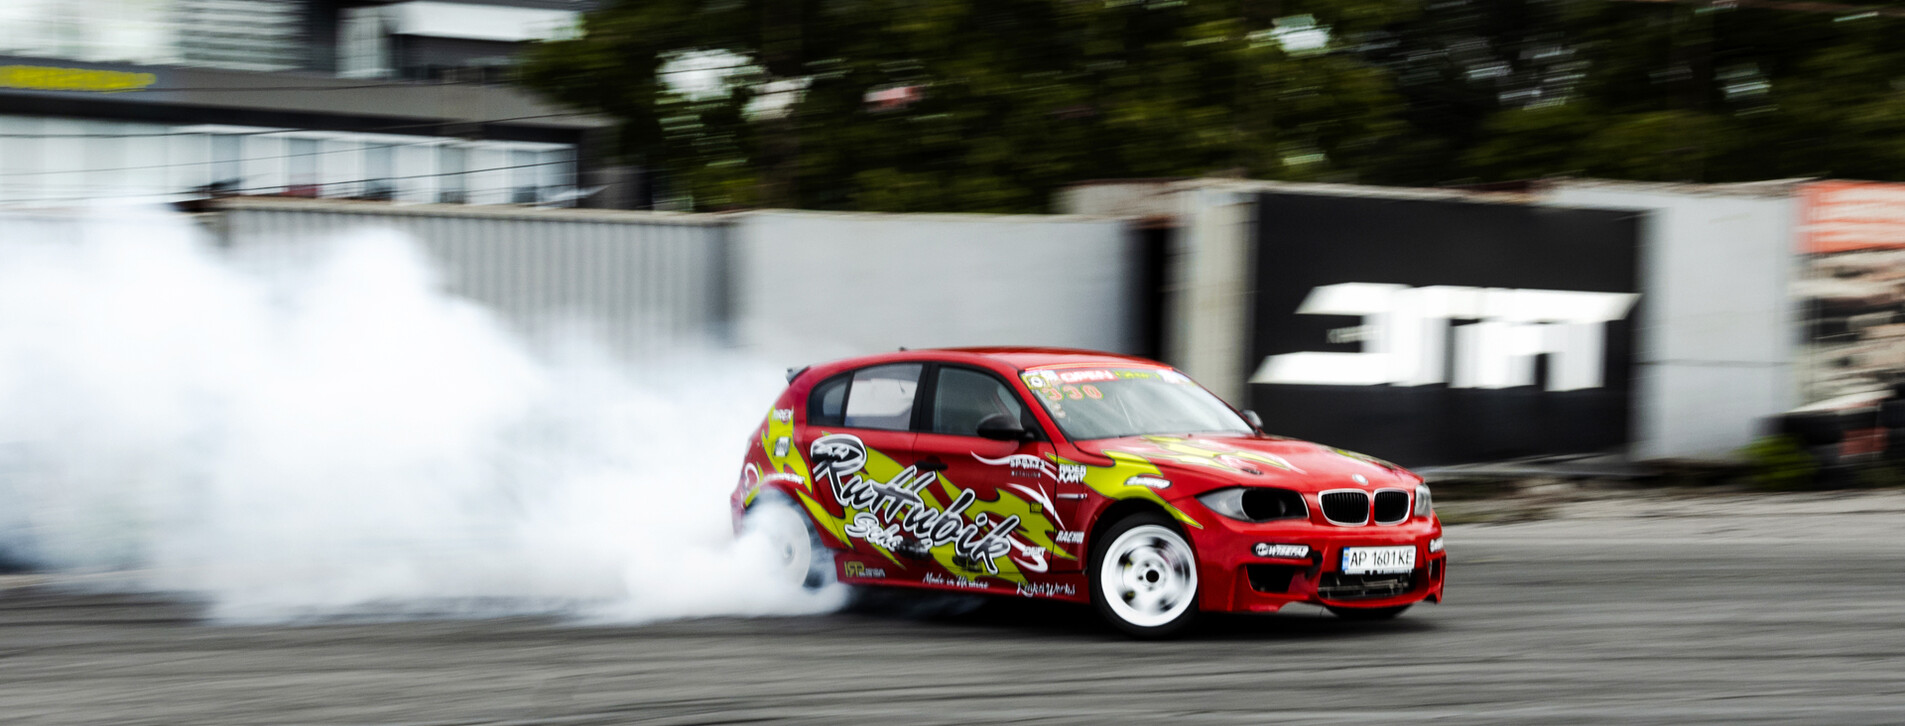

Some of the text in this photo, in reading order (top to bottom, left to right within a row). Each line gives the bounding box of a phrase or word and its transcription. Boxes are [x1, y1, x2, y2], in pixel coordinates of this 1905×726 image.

[1350, 548, 1413, 567] AP 1601 KE
